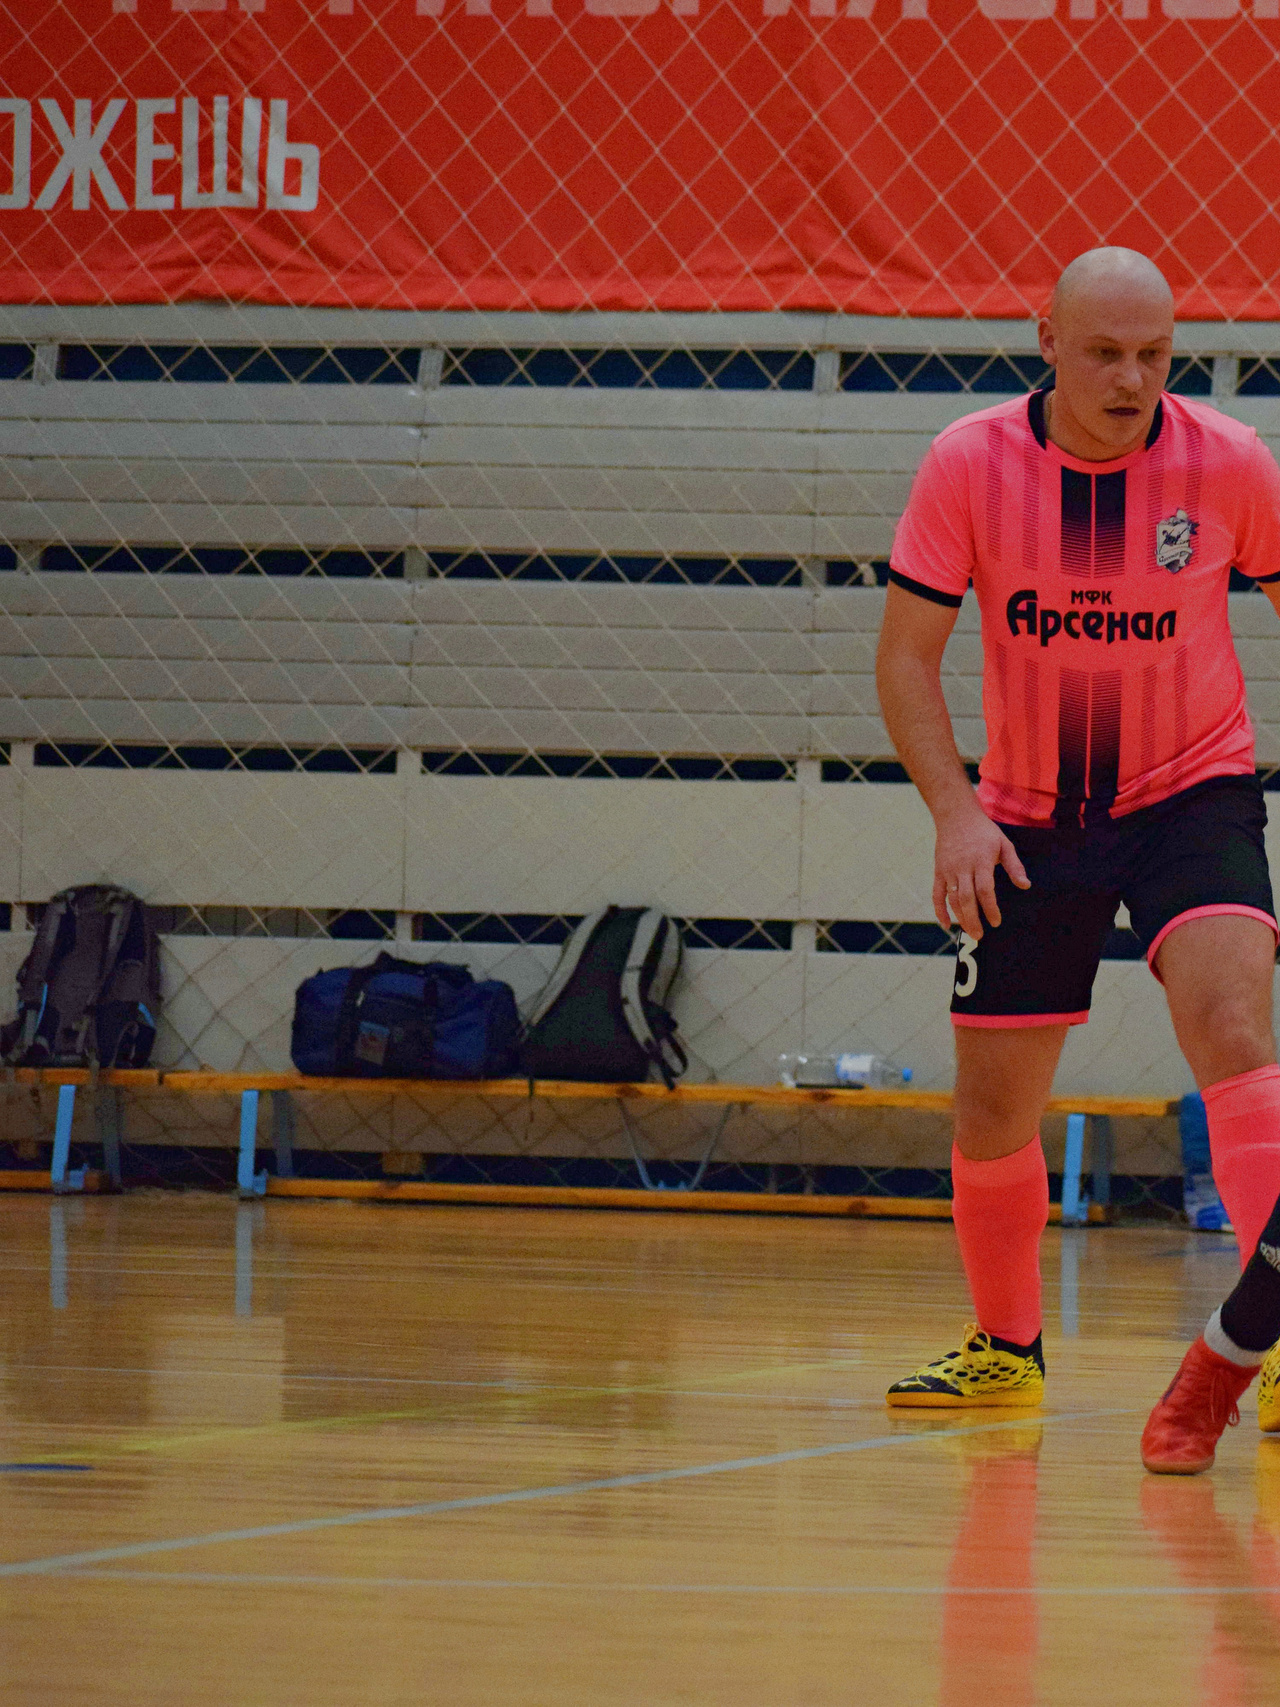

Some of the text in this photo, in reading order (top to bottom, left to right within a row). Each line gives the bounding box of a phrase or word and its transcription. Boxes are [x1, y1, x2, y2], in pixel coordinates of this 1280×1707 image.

[1006, 589, 1177, 647] Арсенал
[1070, 589, 1113, 605] МФК
[954, 931, 979, 998] 3
